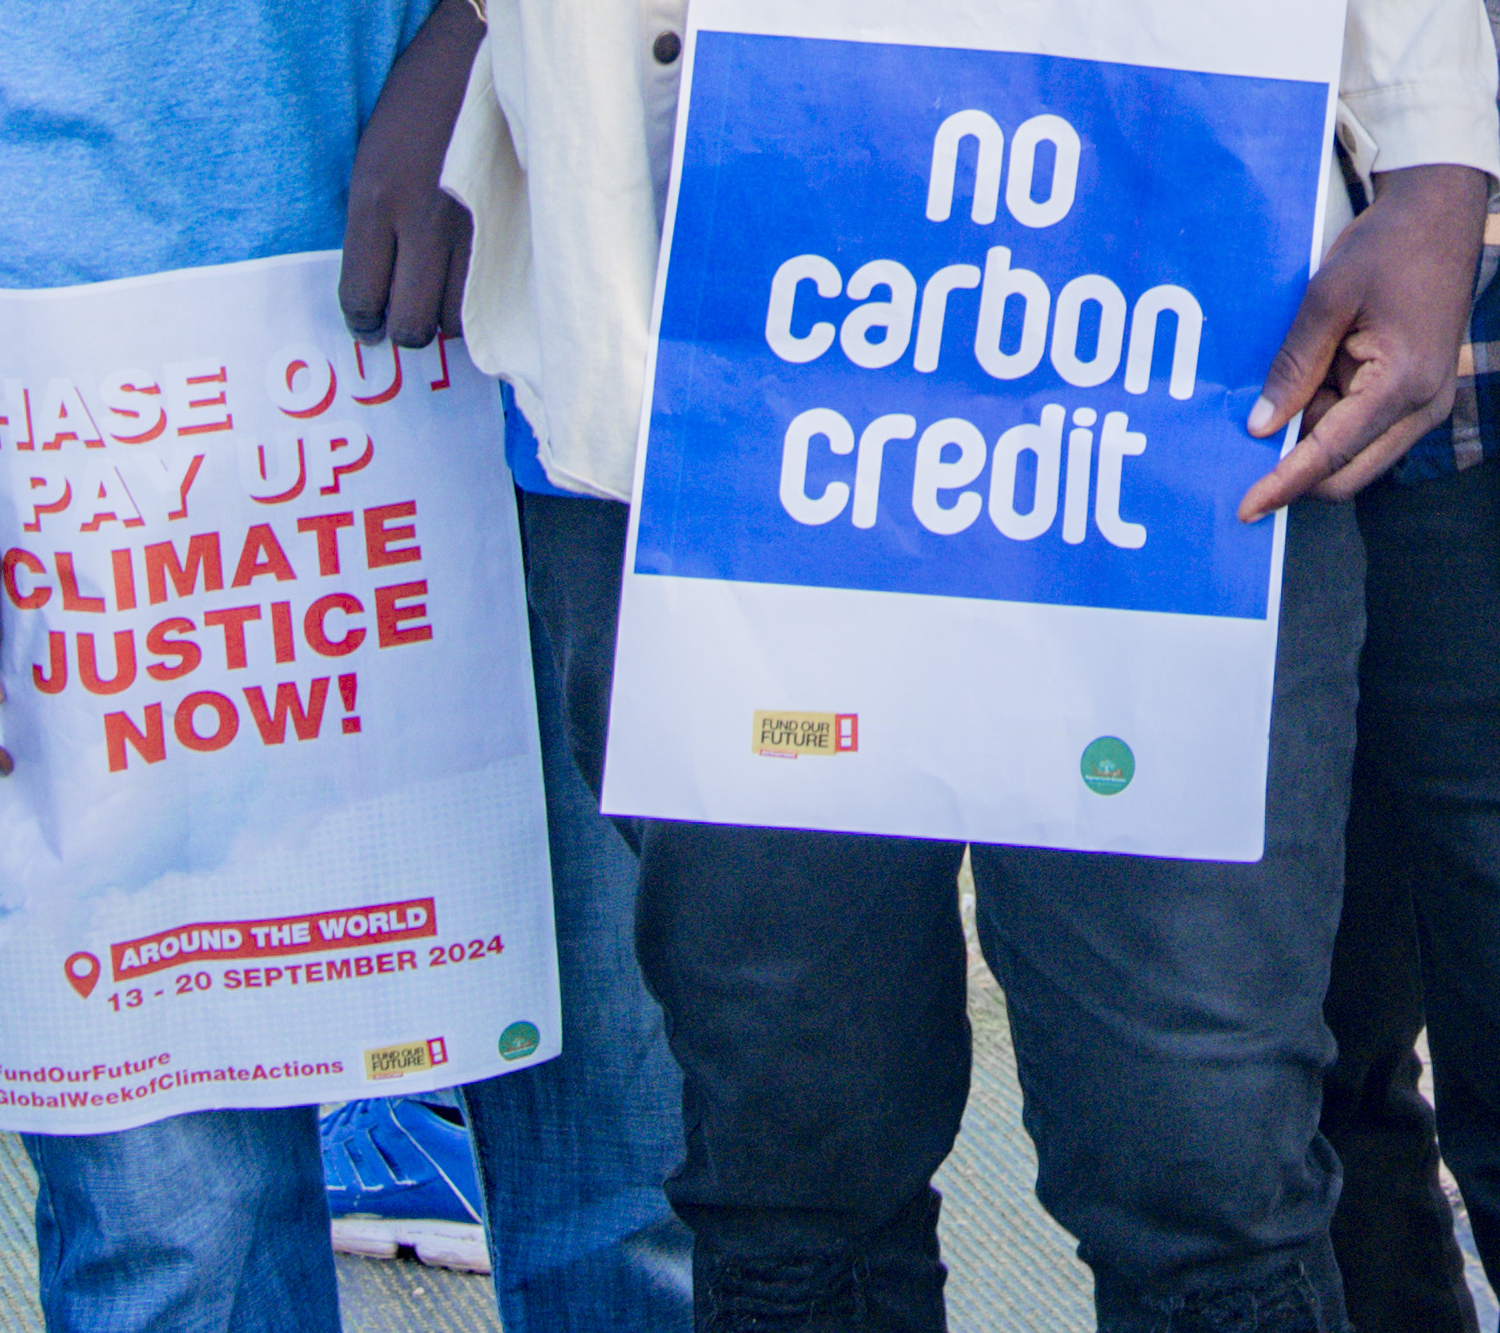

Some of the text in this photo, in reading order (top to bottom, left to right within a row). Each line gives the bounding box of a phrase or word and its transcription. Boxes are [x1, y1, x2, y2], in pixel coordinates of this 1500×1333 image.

[924, 107, 1081, 229] no
[764, 244, 1204, 401] carbon
[10, 419, 375, 533] PAY UP
[777, 401, 1148, 550] credit
[1, 499, 423, 615] CLIMATE
[31, 578, 433, 696] JUSTICE
[103, 672, 362, 773] NOW!
[760, 730, 829, 748] FUTURE
[761, 718, 830, 733] FUND OUR
[107, 934, 506, 1012] 13 20 SEPTEMBER 2024
[119, 905, 429, 971] AROUND THE WORLD
[371, 1046, 424, 1063] FUND OUR
[372, 1055, 426, 1072] FUTURE
